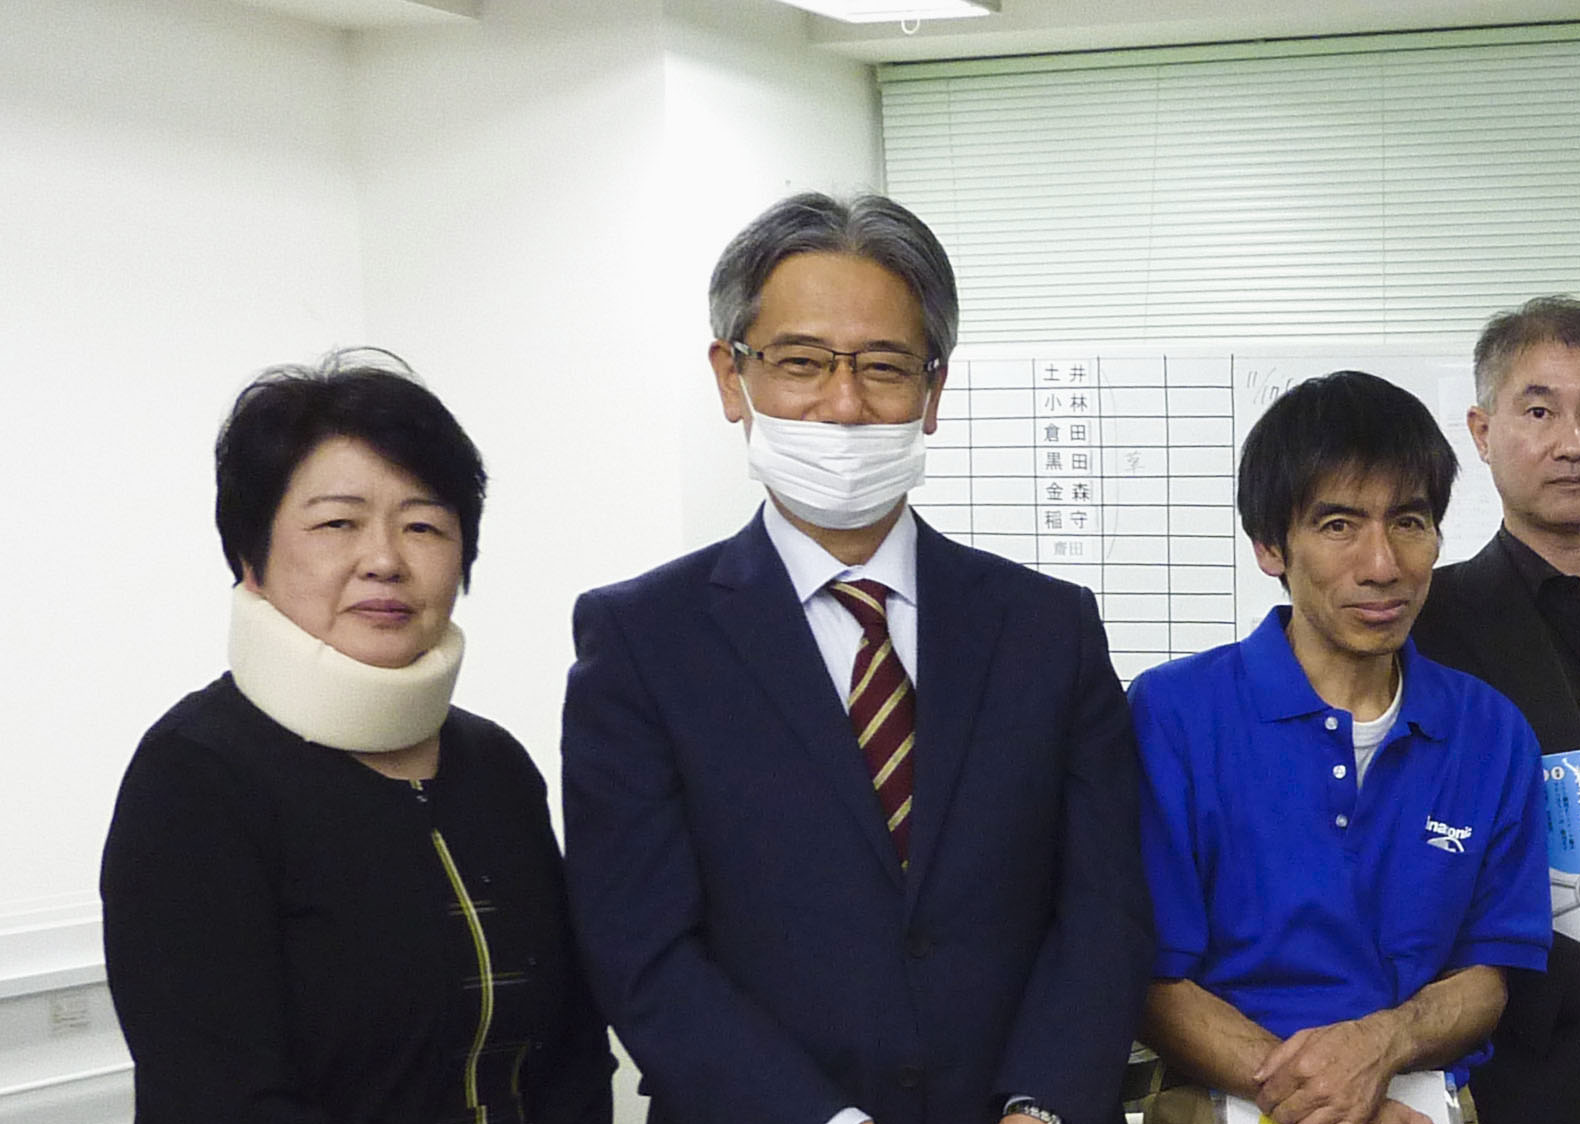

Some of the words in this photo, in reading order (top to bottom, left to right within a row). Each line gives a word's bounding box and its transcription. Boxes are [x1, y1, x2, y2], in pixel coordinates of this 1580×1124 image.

[1043, 364, 1087, 382] 土井
[1044, 392, 1088, 412] 小林
[1046, 452, 1089, 470] 黒田
[1046, 482, 1090, 501] 金森
